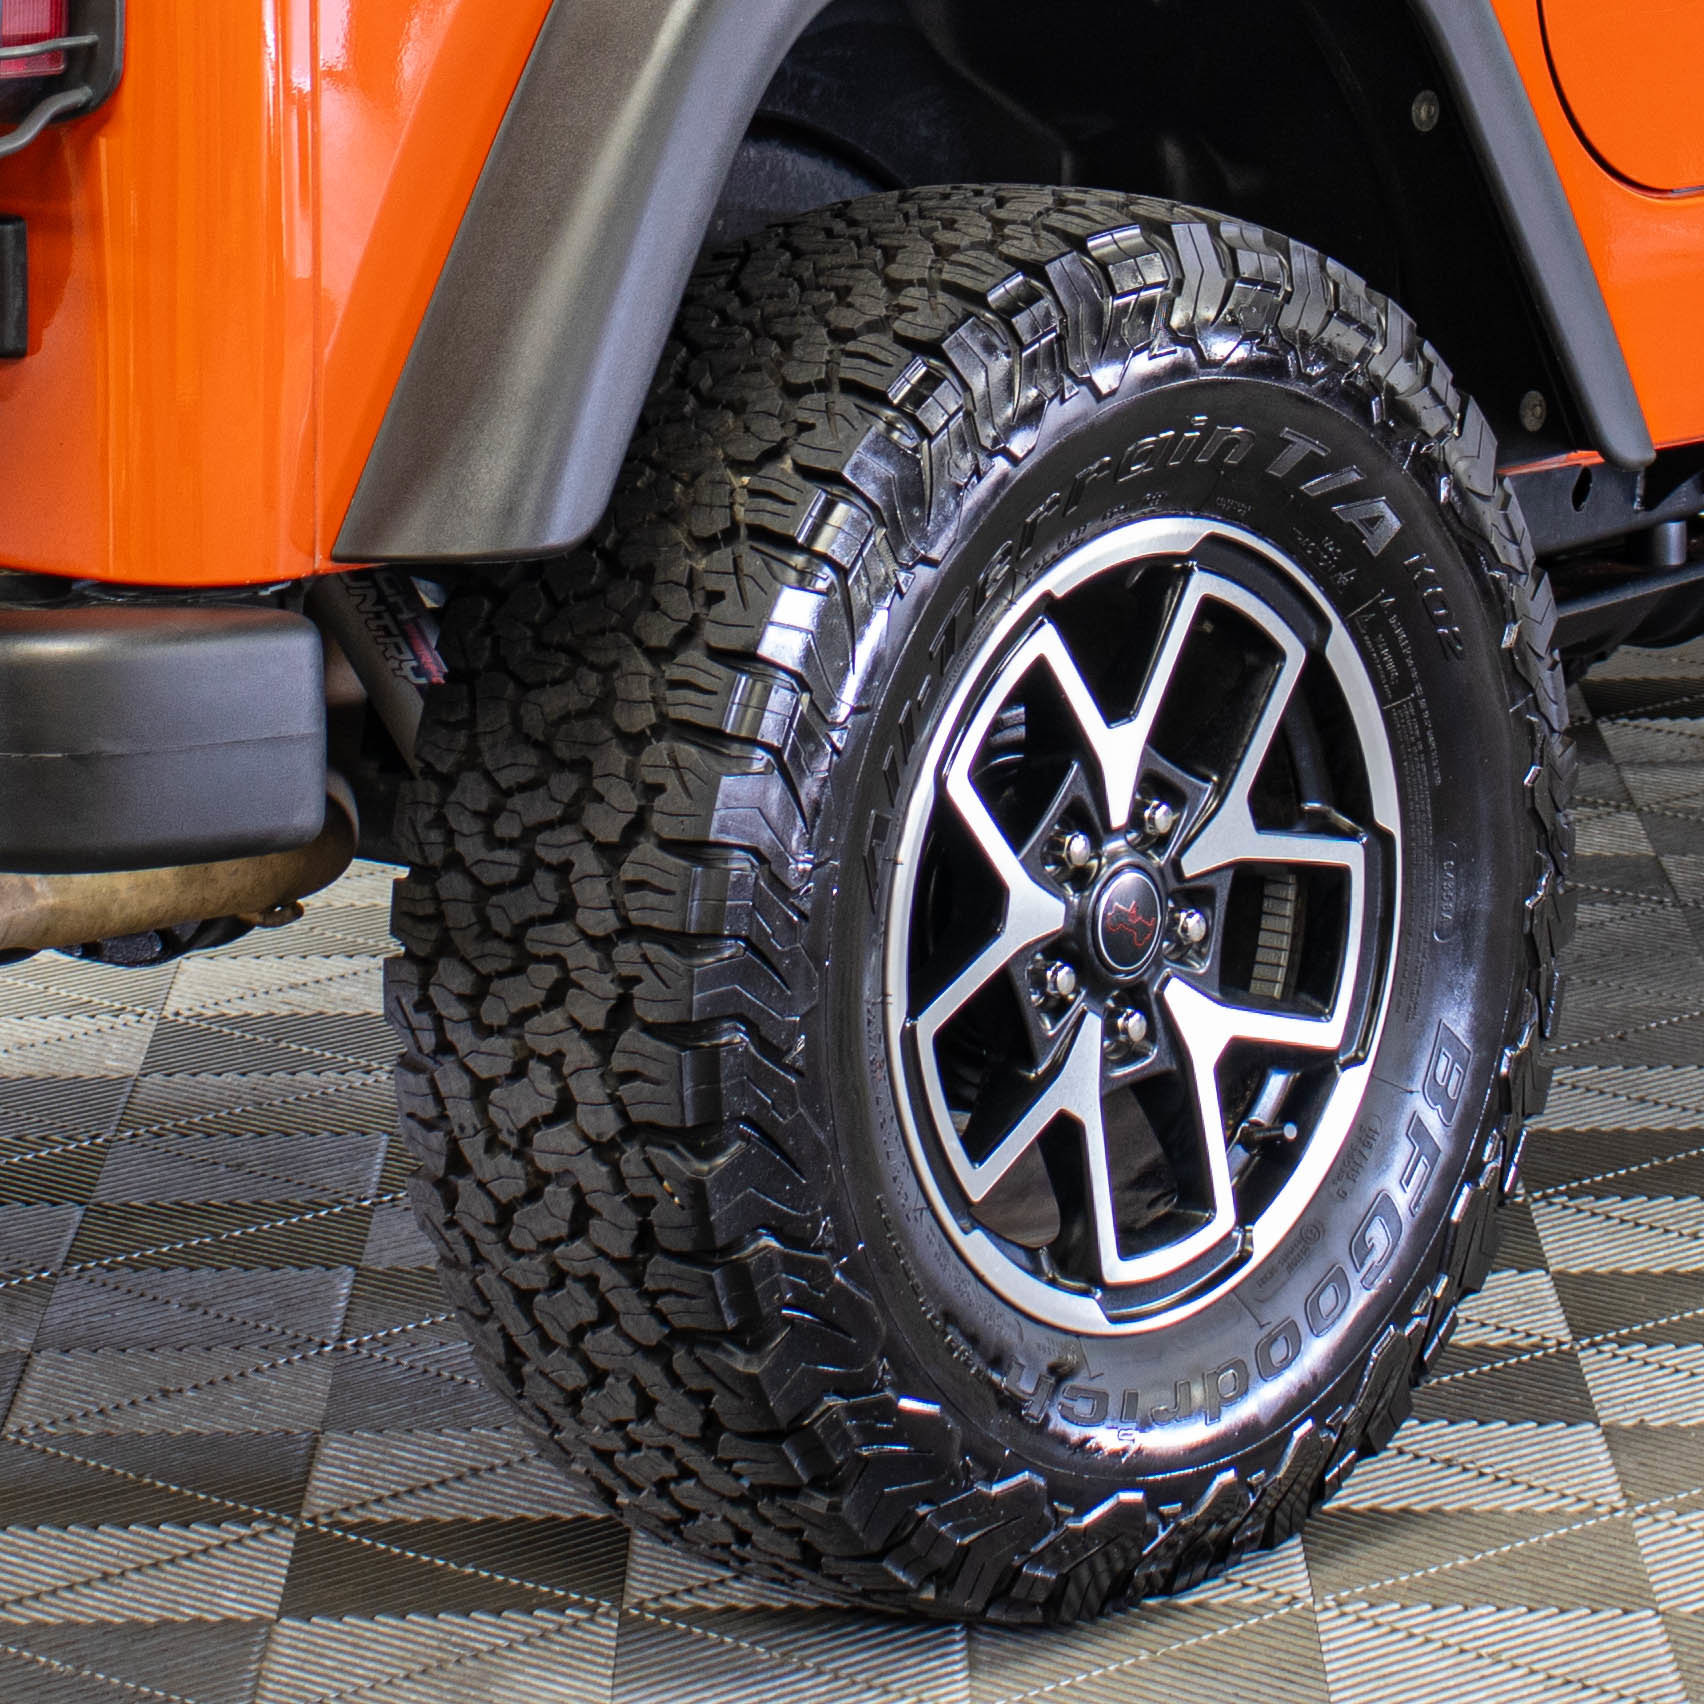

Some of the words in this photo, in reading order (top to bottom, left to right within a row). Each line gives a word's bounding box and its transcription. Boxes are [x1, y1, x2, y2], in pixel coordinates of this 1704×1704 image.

[338, 570, 428, 687] UNTRY
[1264, 426, 1405, 558] T/A
[1403, 552, 1464, 662] KO2
[1003, 1018, 1473, 1443] BFGoodrich
